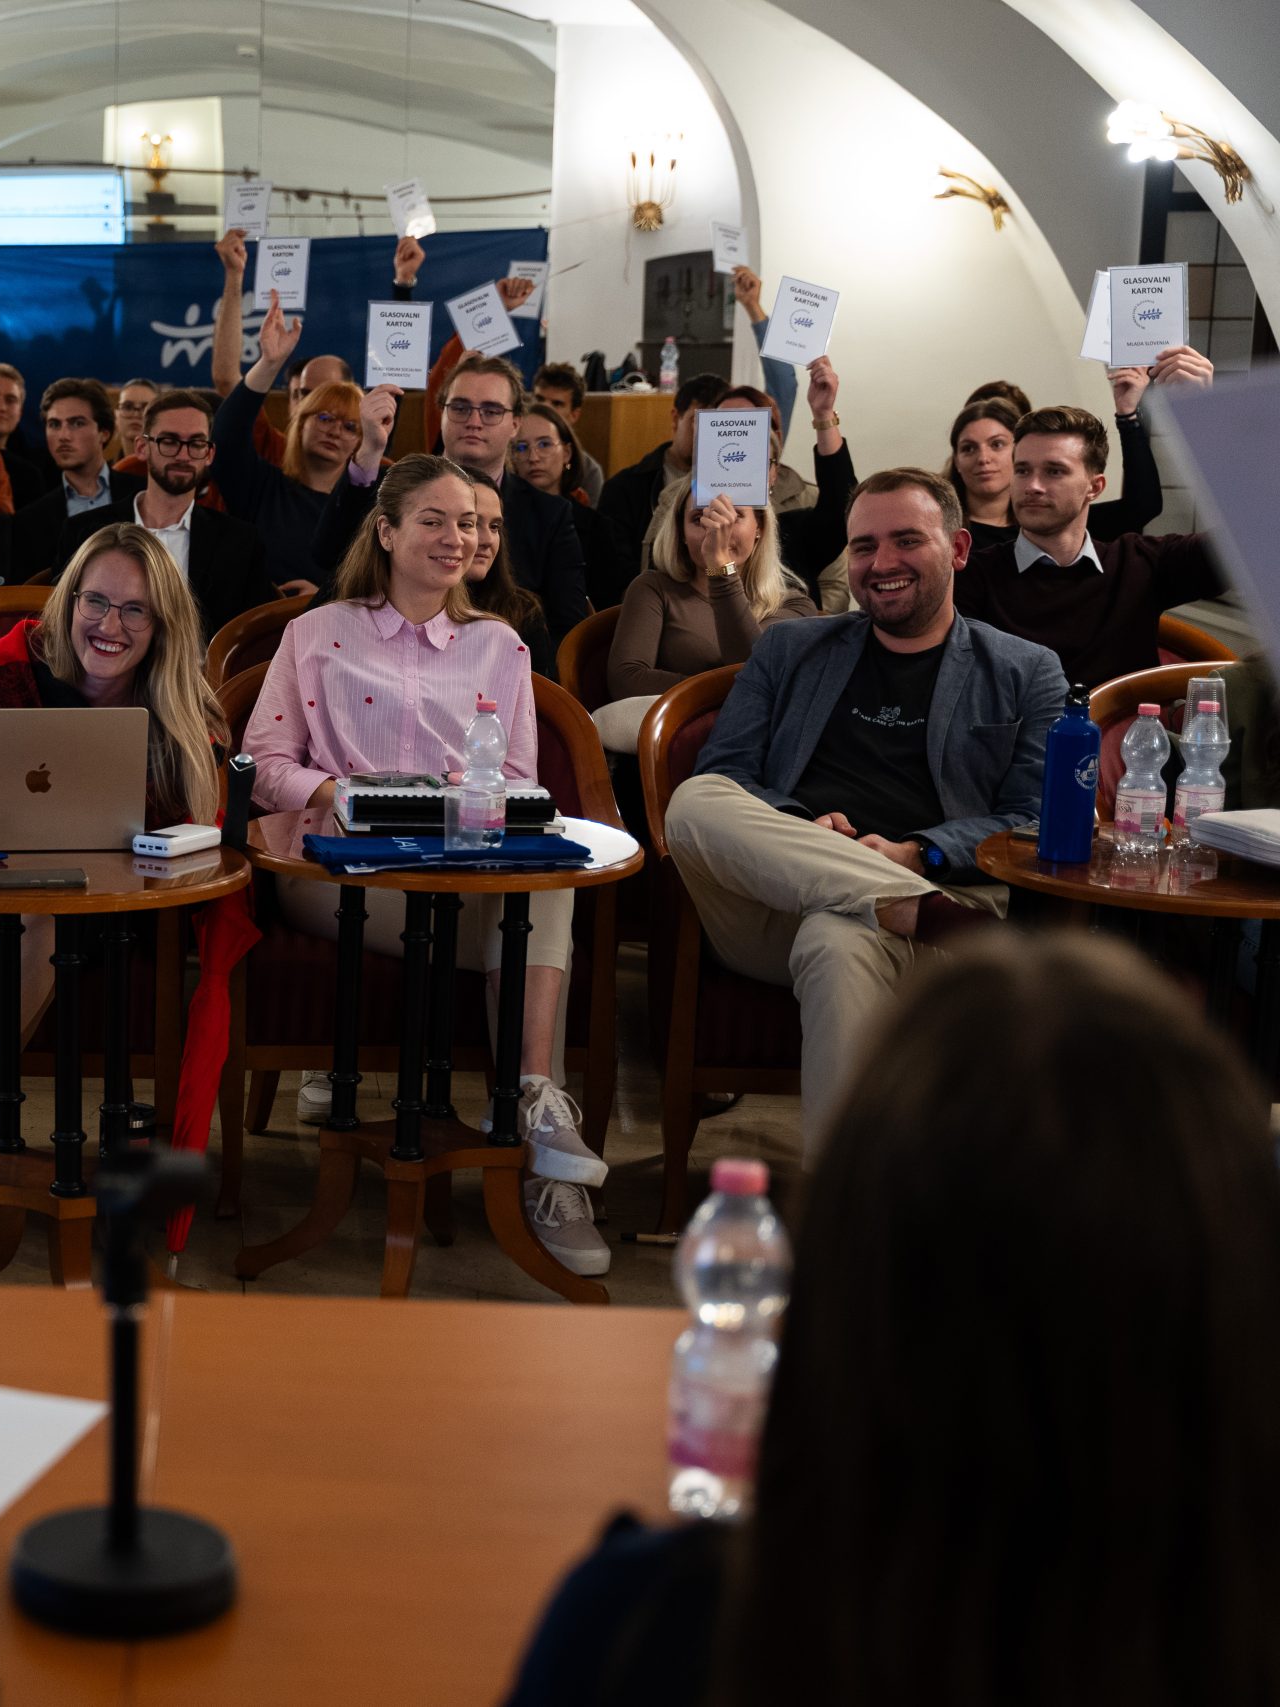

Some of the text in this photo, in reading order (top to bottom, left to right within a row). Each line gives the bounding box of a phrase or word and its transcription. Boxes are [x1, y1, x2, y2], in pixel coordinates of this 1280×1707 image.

[1122, 276, 1171, 285] GLASOVALNI
[789, 286, 828, 302] GLASOVALNI
[1131, 287, 1163, 295] KARTON
[793, 296, 820, 309] KARTON
[379, 311, 420, 319] GLASOVALNI
[710, 419, 757, 427] GLASOVALNI
[872, 717, 887, 726] CARE
[906, 718, 925, 727] EARTH
